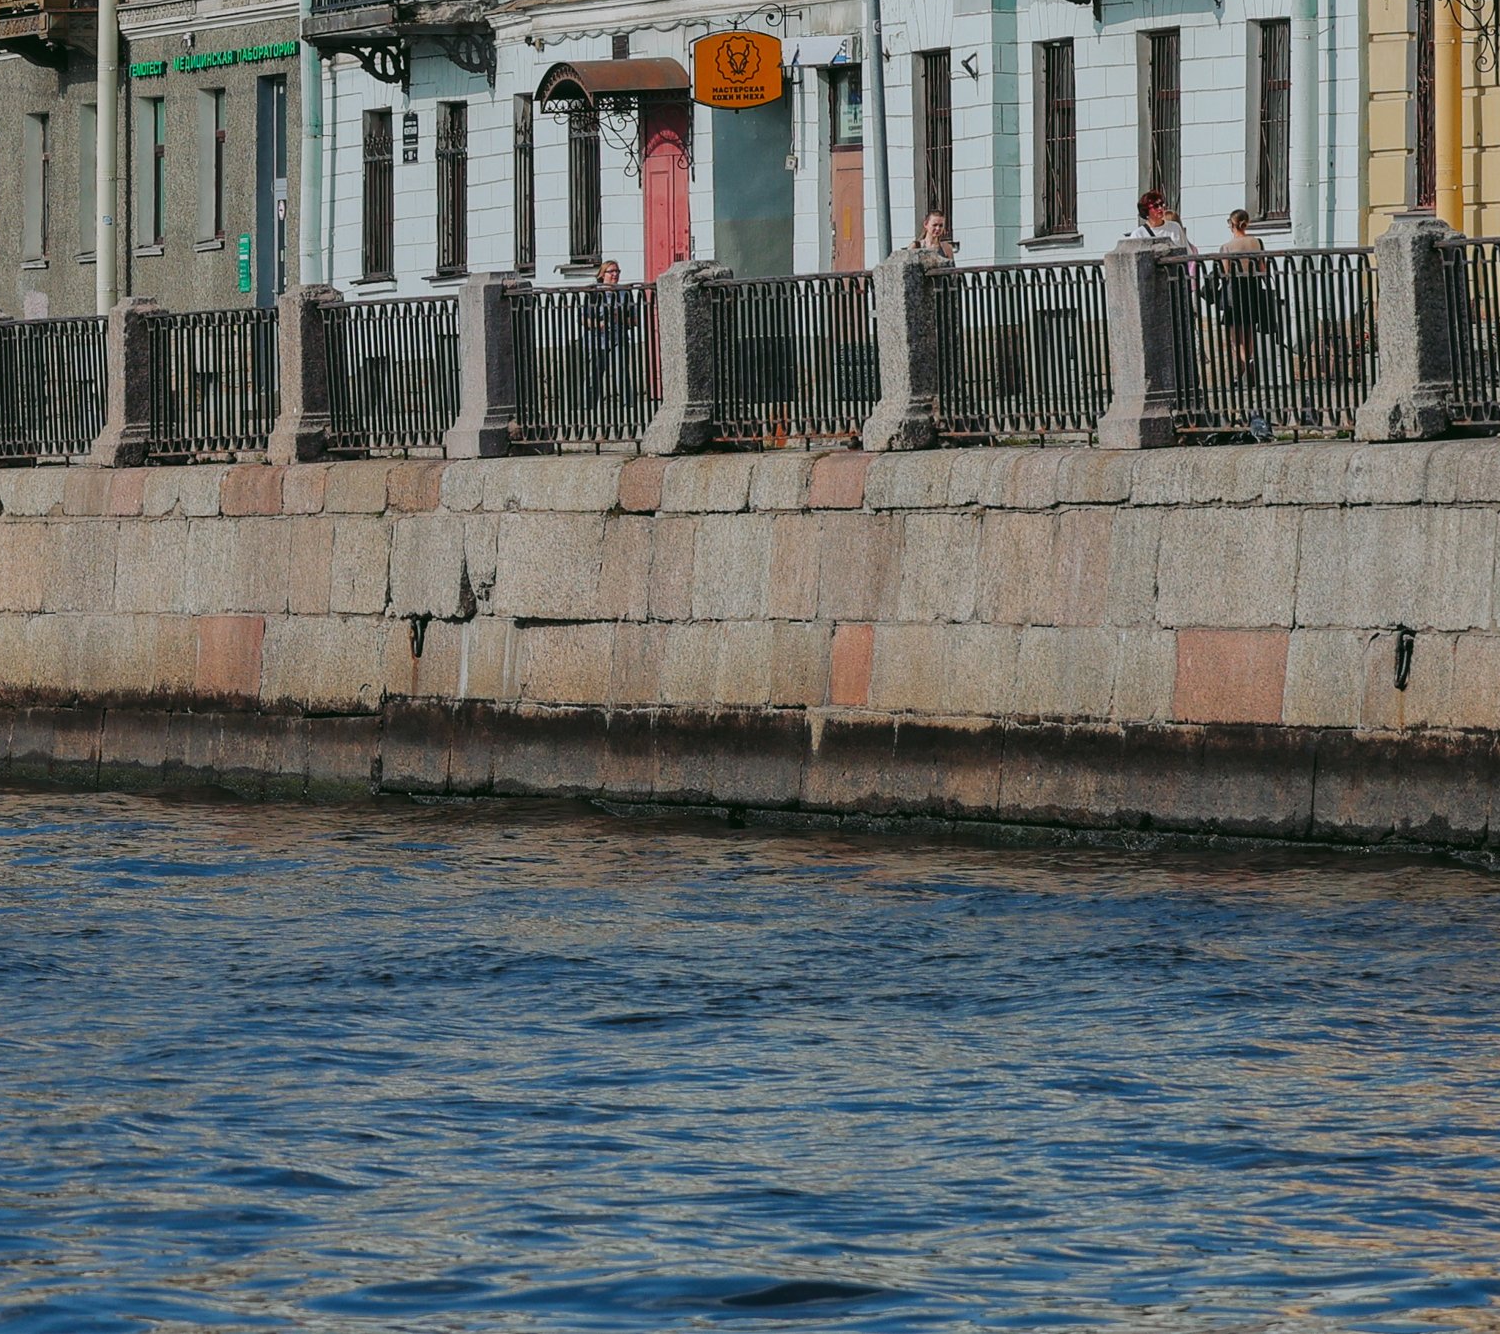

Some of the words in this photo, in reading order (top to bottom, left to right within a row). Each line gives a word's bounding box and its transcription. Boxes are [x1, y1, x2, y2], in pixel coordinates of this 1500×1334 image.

[129, 61, 163, 78] ГЕМОТЕСТ
[173, 51, 233, 72] МЕДИЦИНСКАЯ
[712, 85, 765, 93] МАСТЕРСКАЯ
